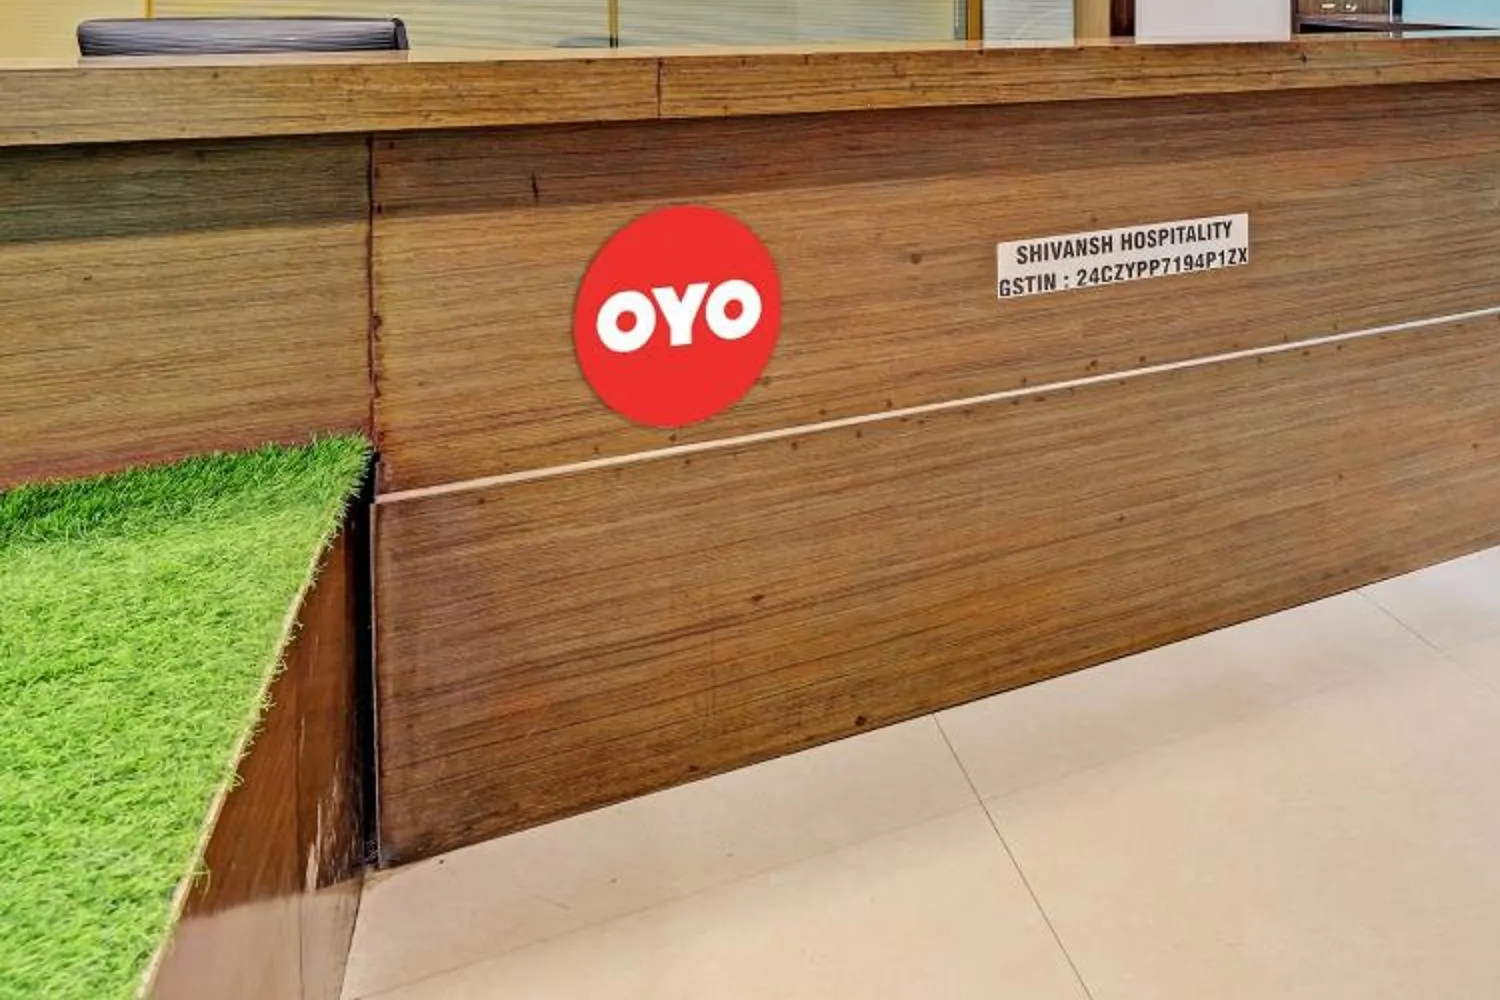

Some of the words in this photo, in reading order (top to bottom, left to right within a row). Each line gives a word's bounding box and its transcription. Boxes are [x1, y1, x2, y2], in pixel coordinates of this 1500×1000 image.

[1016, 235, 1113, 265] SHIVANSH
[1121, 220, 1233, 251] HOSPITALITY
[999, 273, 1057, 297] GSTIN
[1076, 247, 1248, 287] 24CZYPP7194P1ZX
[596, 279, 762, 353] OYO
